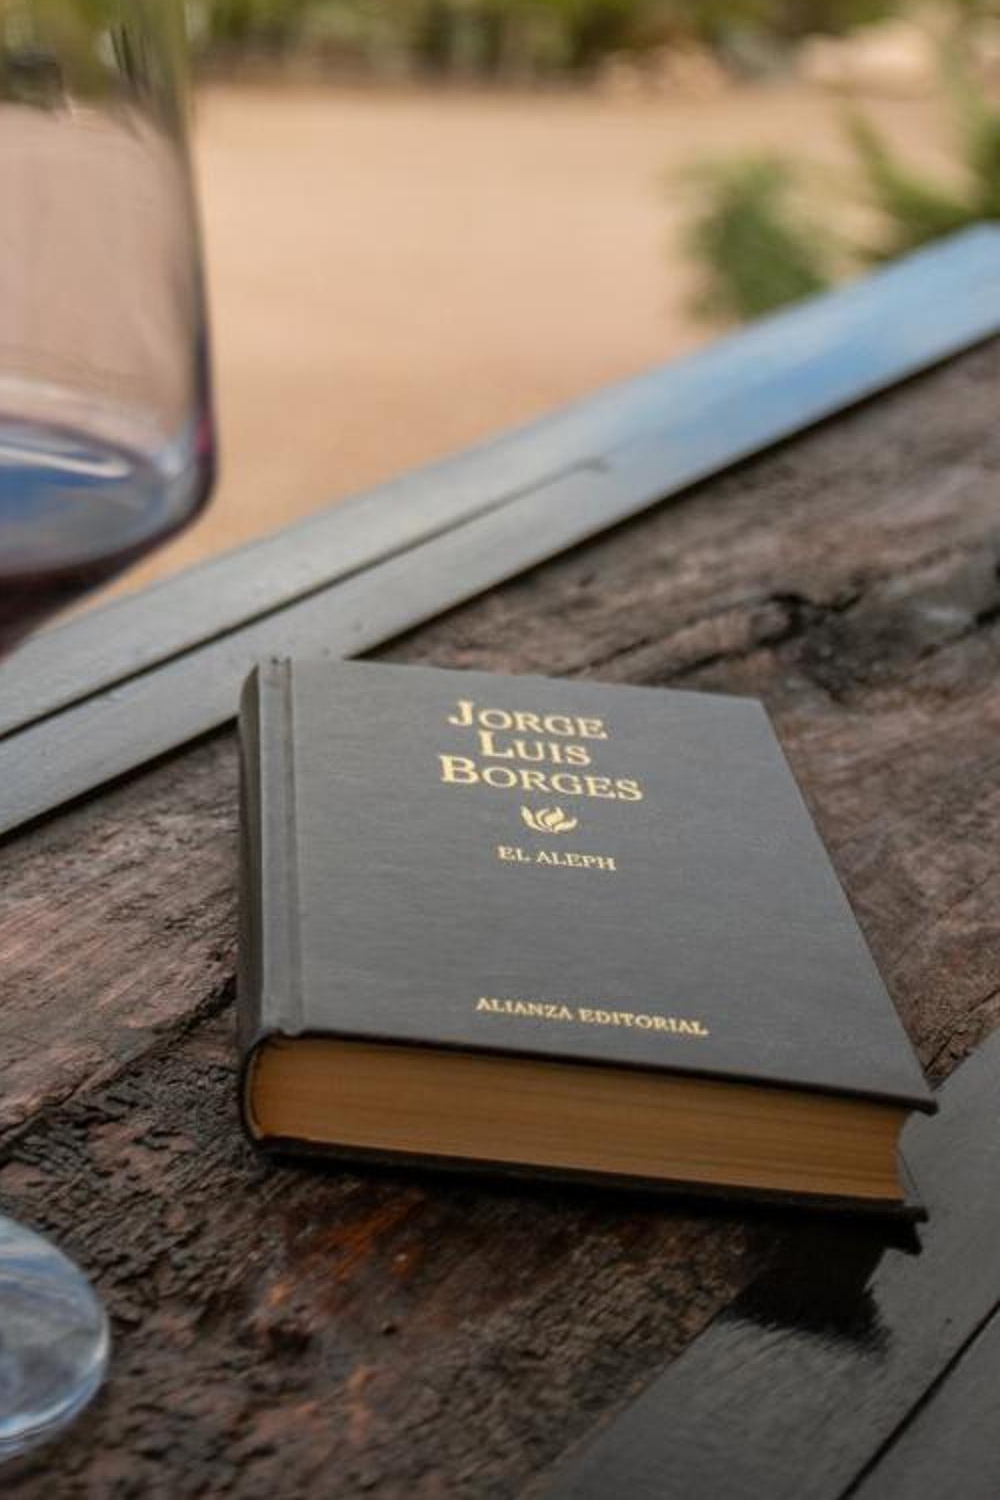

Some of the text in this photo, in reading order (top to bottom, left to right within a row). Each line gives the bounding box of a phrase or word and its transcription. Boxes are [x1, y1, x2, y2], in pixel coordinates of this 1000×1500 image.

[448, 700, 608, 740] JORGE
[478, 730, 592, 766] LUIS
[440, 755, 643, 801] BORGES
[498, 845, 616, 871] EL ALEPH
[476, 997, 709, 1036] ALIANZA EDITORIAL
